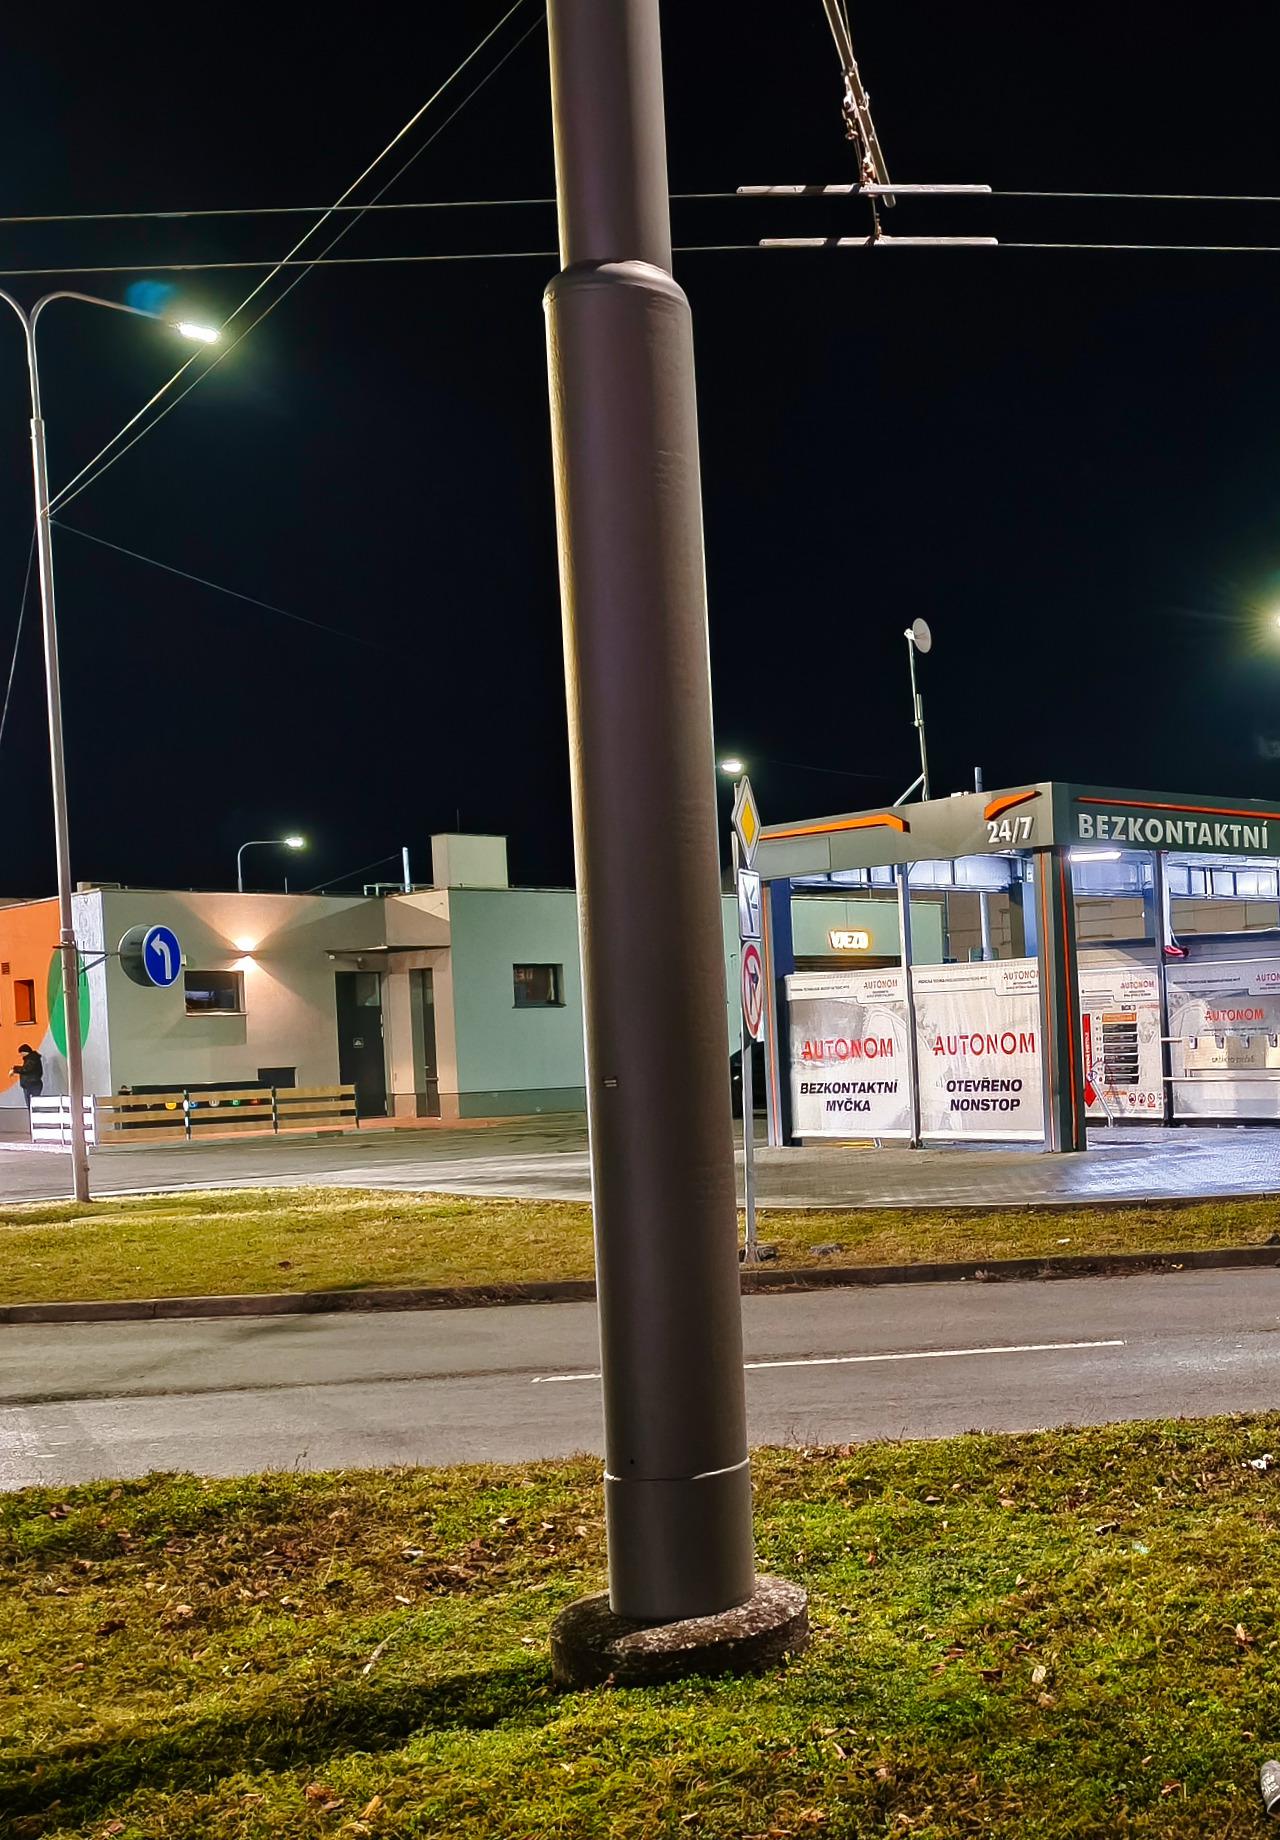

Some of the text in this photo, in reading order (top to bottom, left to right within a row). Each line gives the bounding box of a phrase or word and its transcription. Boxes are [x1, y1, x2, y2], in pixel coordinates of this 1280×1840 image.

[987, 816, 1033, 844] 24/7
[1077, 813, 1268, 850] BEZKONTAKTNÍ
[1204, 1007, 1264, 1021] AUTONOM
[801, 1038, 894, 1061] AUTONOM
[931, 1031, 1036, 1056] AUTONOM
[800, 1078, 899, 1095] BEZKONTAKTNÍ
[946, 1076, 1023, 1093] OTEVŘENO
[826, 1097, 872, 1112] MYČKA
[950, 1099, 1021, 1112] NONSTOP
